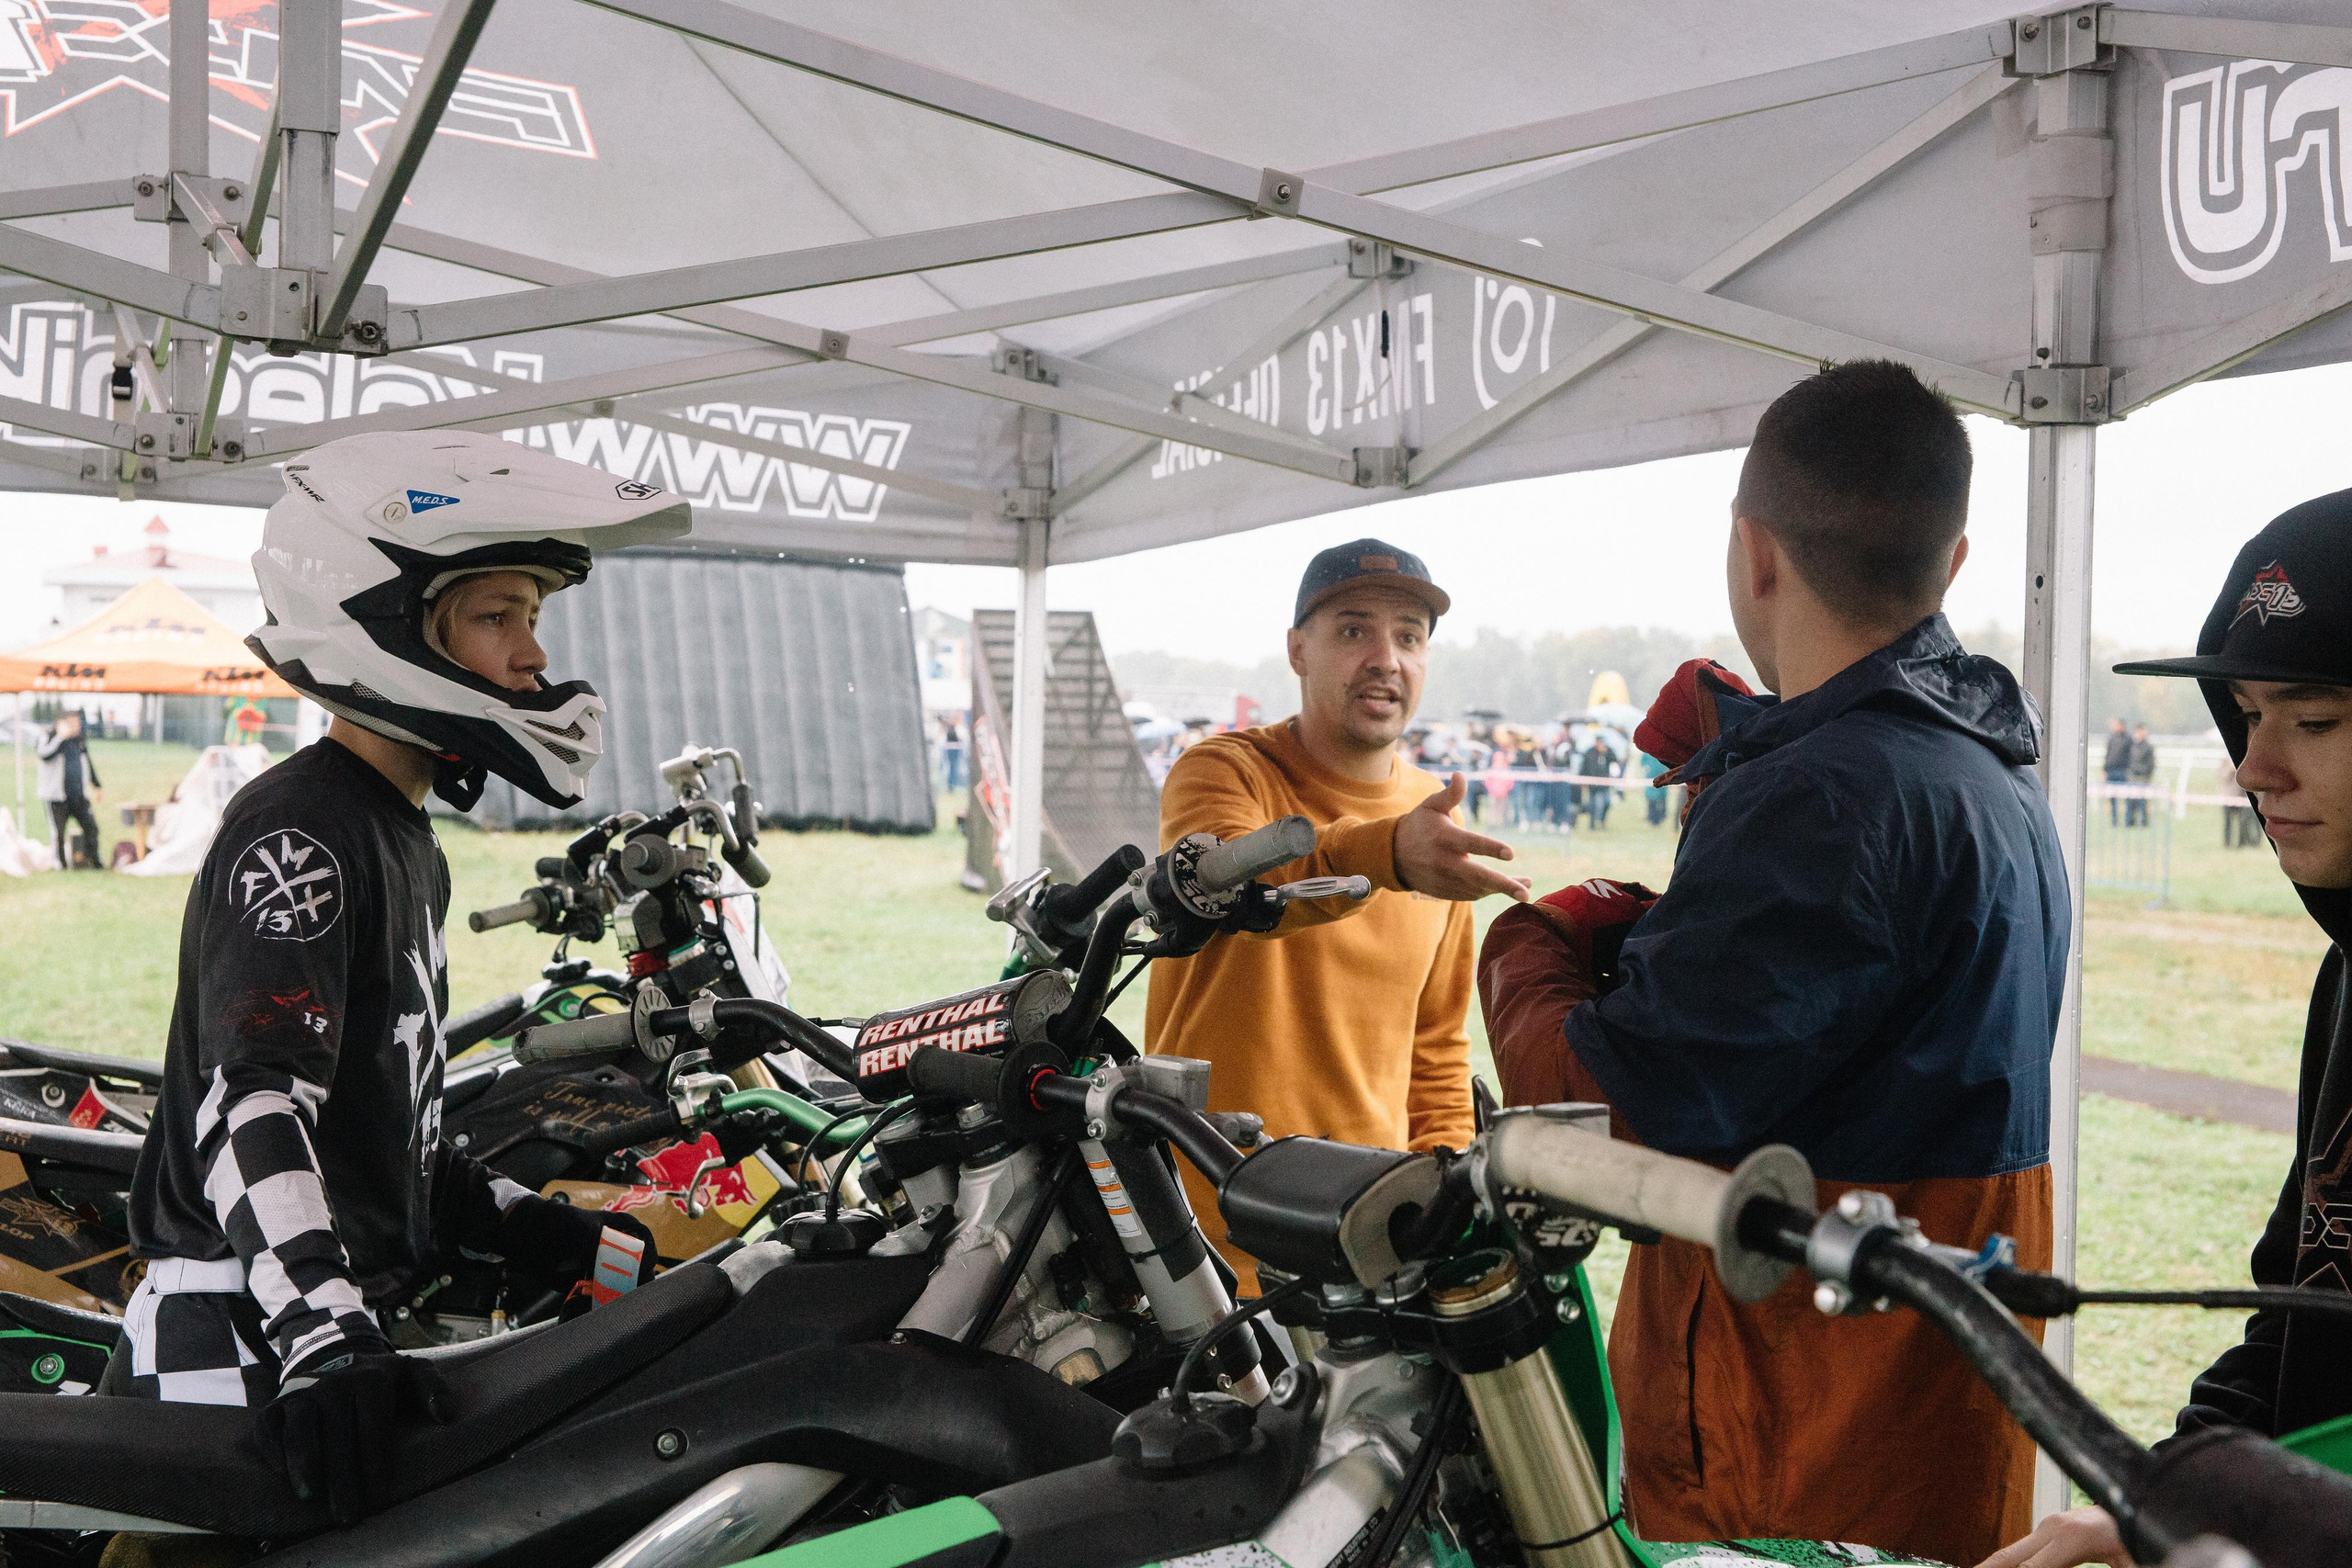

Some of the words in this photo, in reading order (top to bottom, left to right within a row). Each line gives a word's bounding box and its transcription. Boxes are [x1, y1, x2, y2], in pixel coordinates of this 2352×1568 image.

[411, 495, 449, 505] M.E.D.S.
[304, 1012, 328, 1033] 13
[858, 992, 1006, 1047] RENTHAL
[858, 1018, 1006, 1077] RENTHAL
